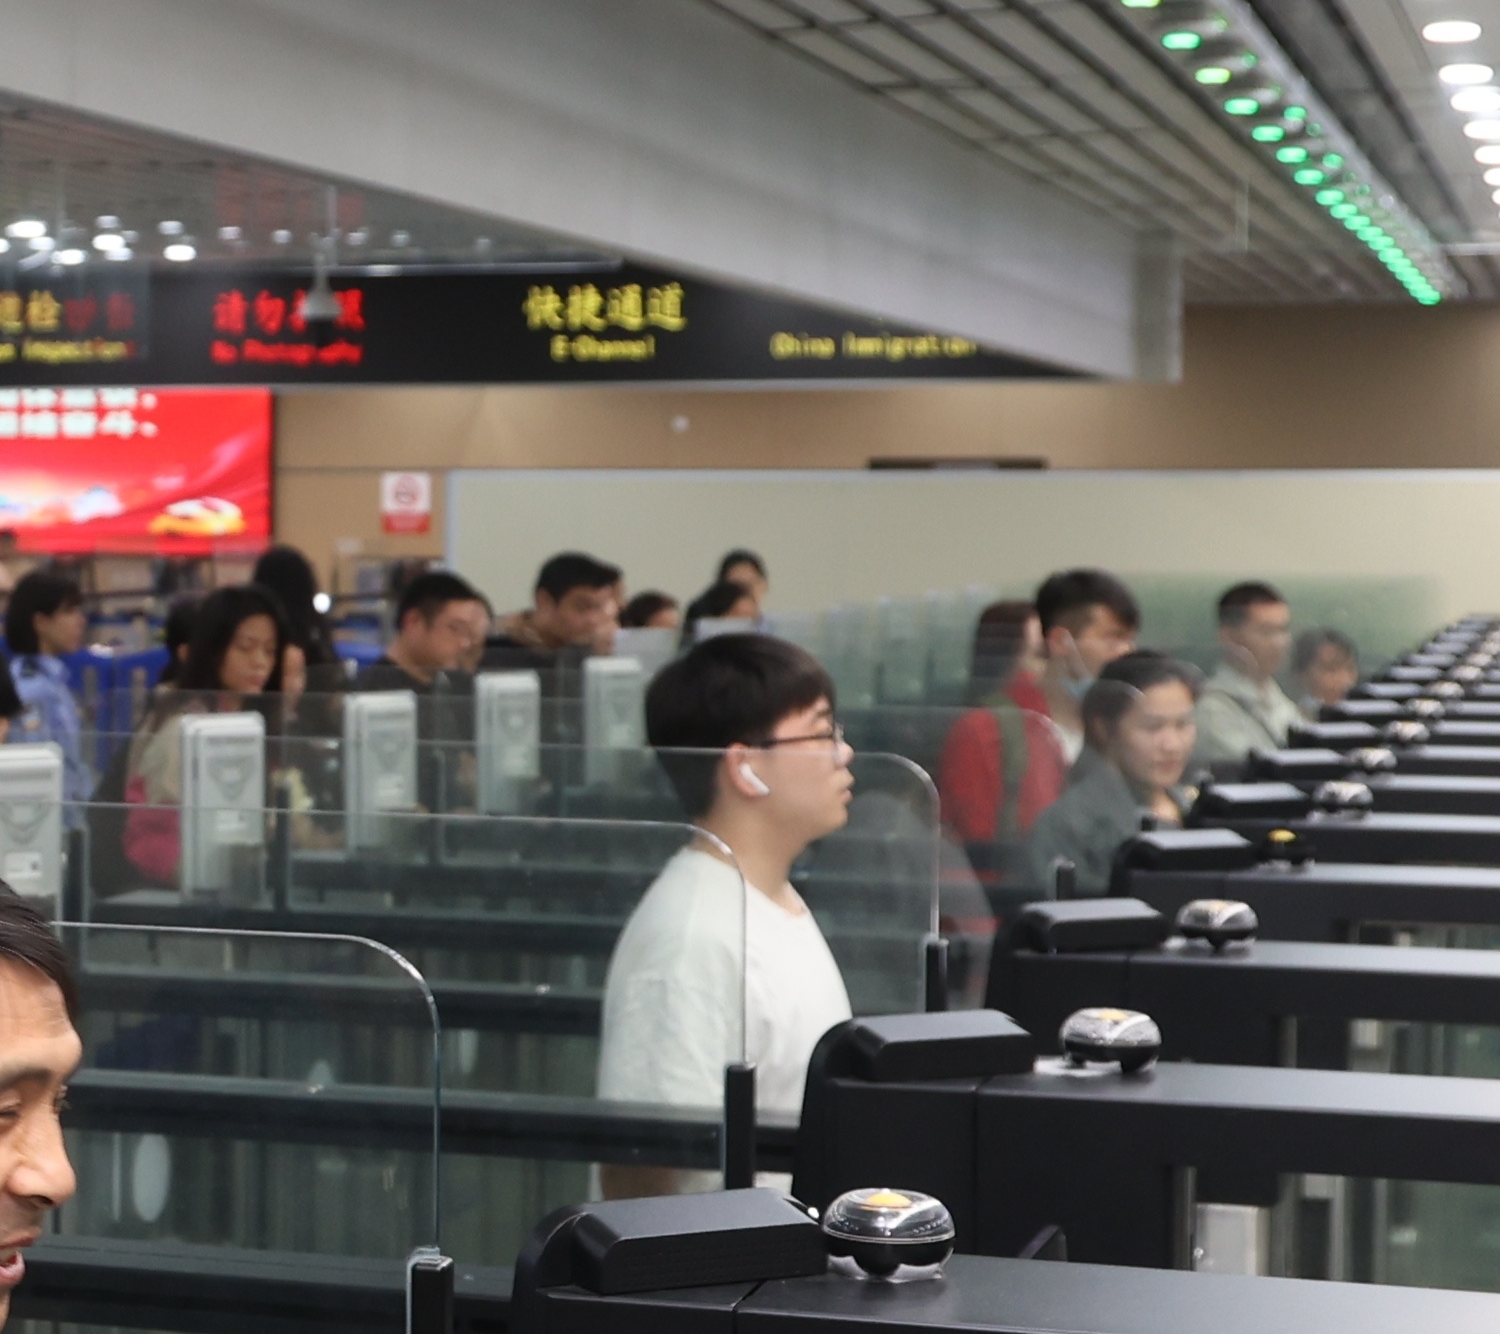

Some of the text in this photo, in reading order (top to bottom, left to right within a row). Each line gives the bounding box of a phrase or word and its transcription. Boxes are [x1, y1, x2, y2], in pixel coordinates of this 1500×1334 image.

[522, 282, 687, 332] 快捷通道
[769, 331, 836, 361] China
